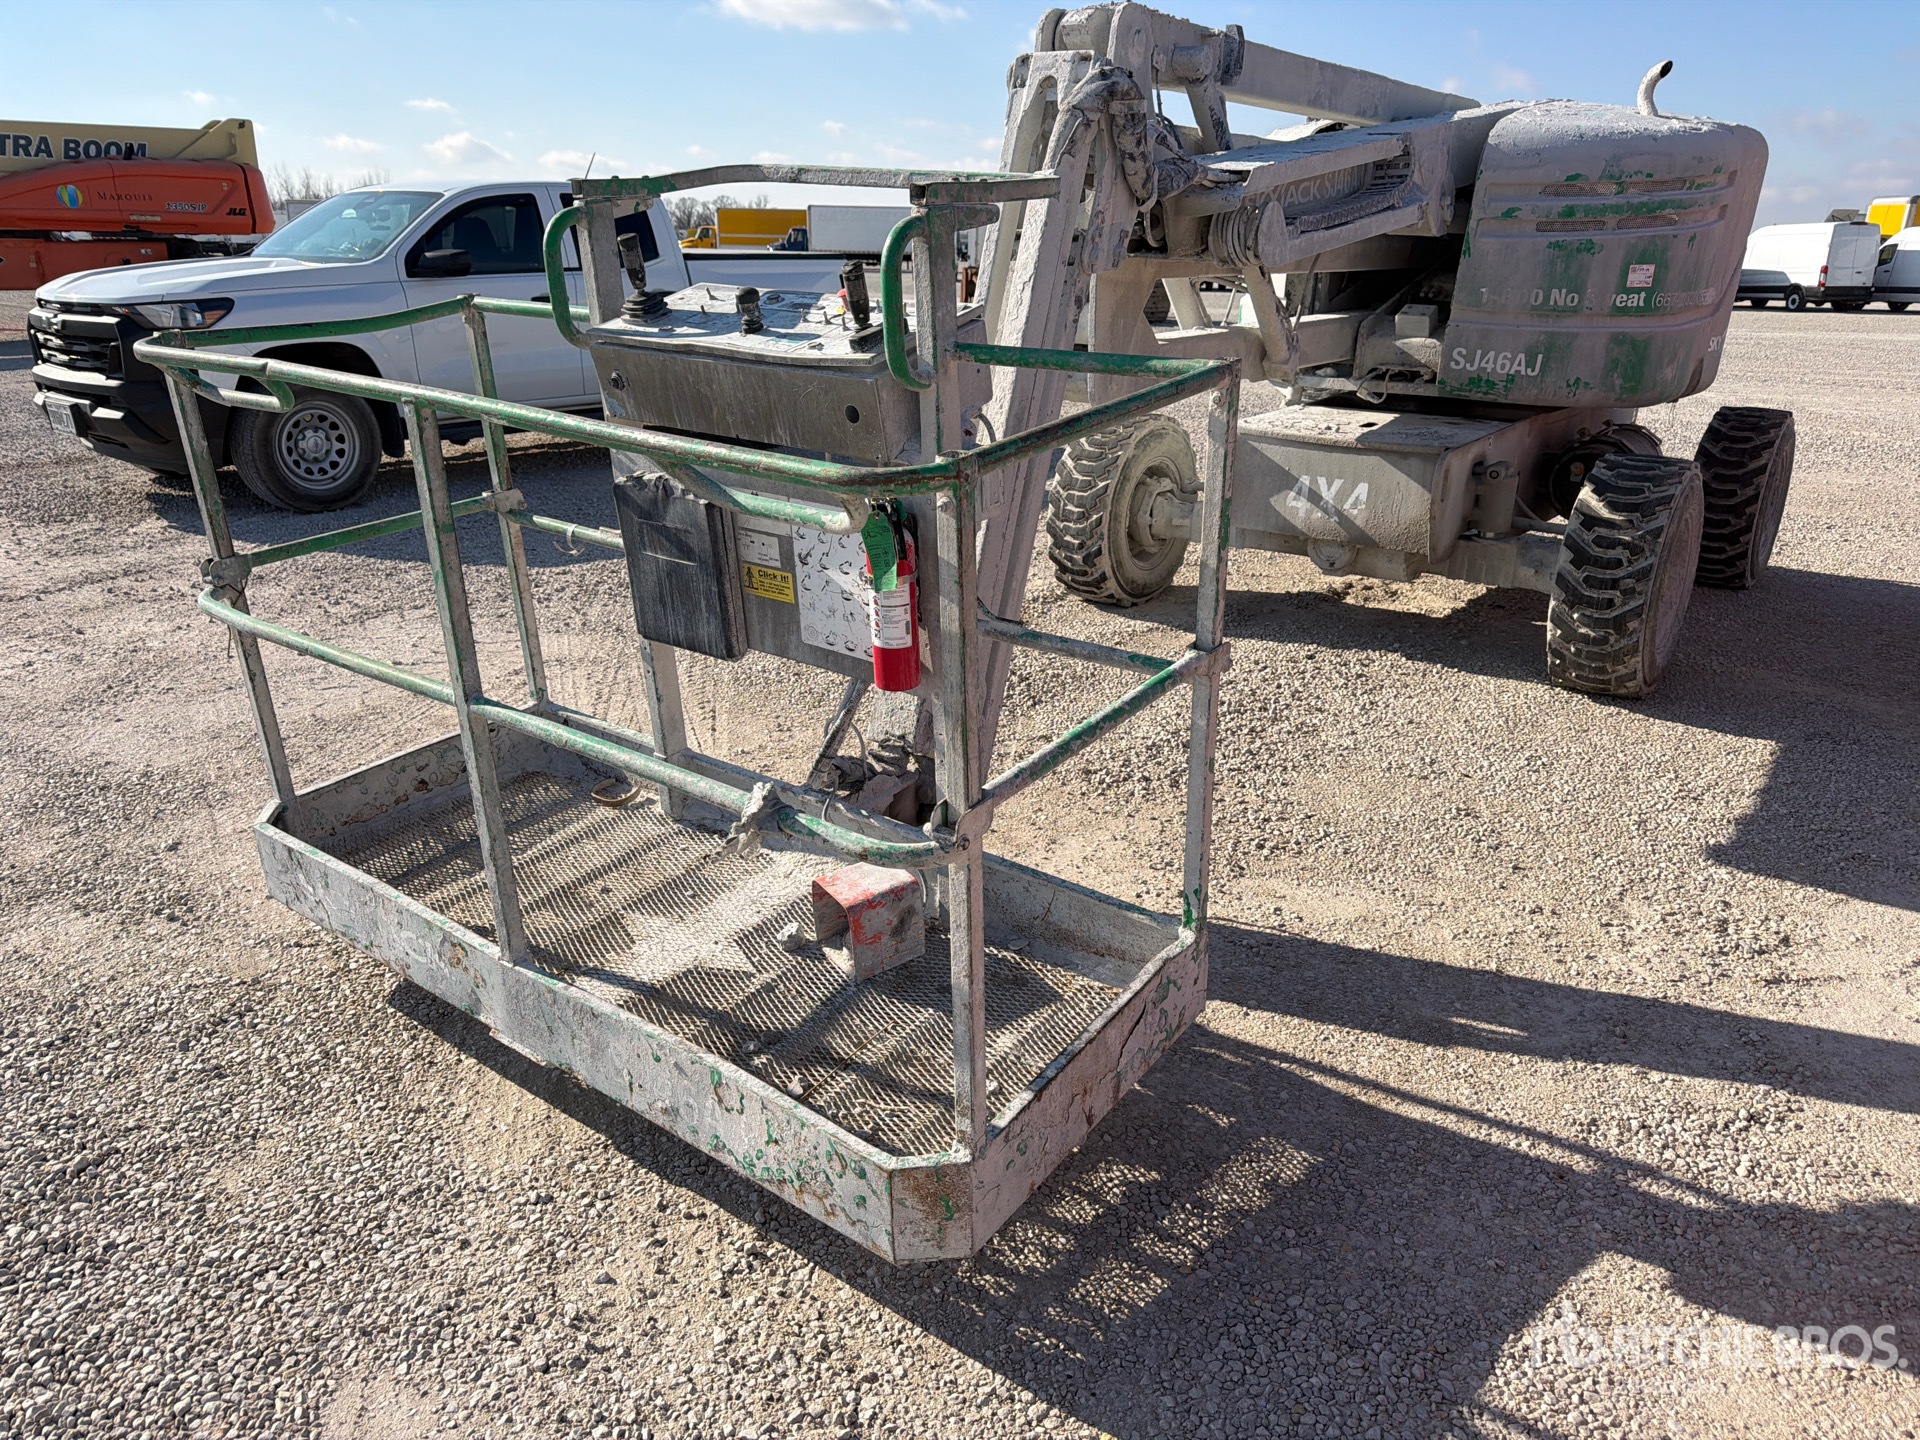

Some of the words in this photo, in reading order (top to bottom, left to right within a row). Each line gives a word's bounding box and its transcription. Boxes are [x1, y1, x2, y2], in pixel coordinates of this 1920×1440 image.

[226, 207, 247, 216] JLG
[1549, 288, 1580, 307] No
[1449, 347, 1544, 377] SJ46AJ
[757, 569, 778, 580] Click
